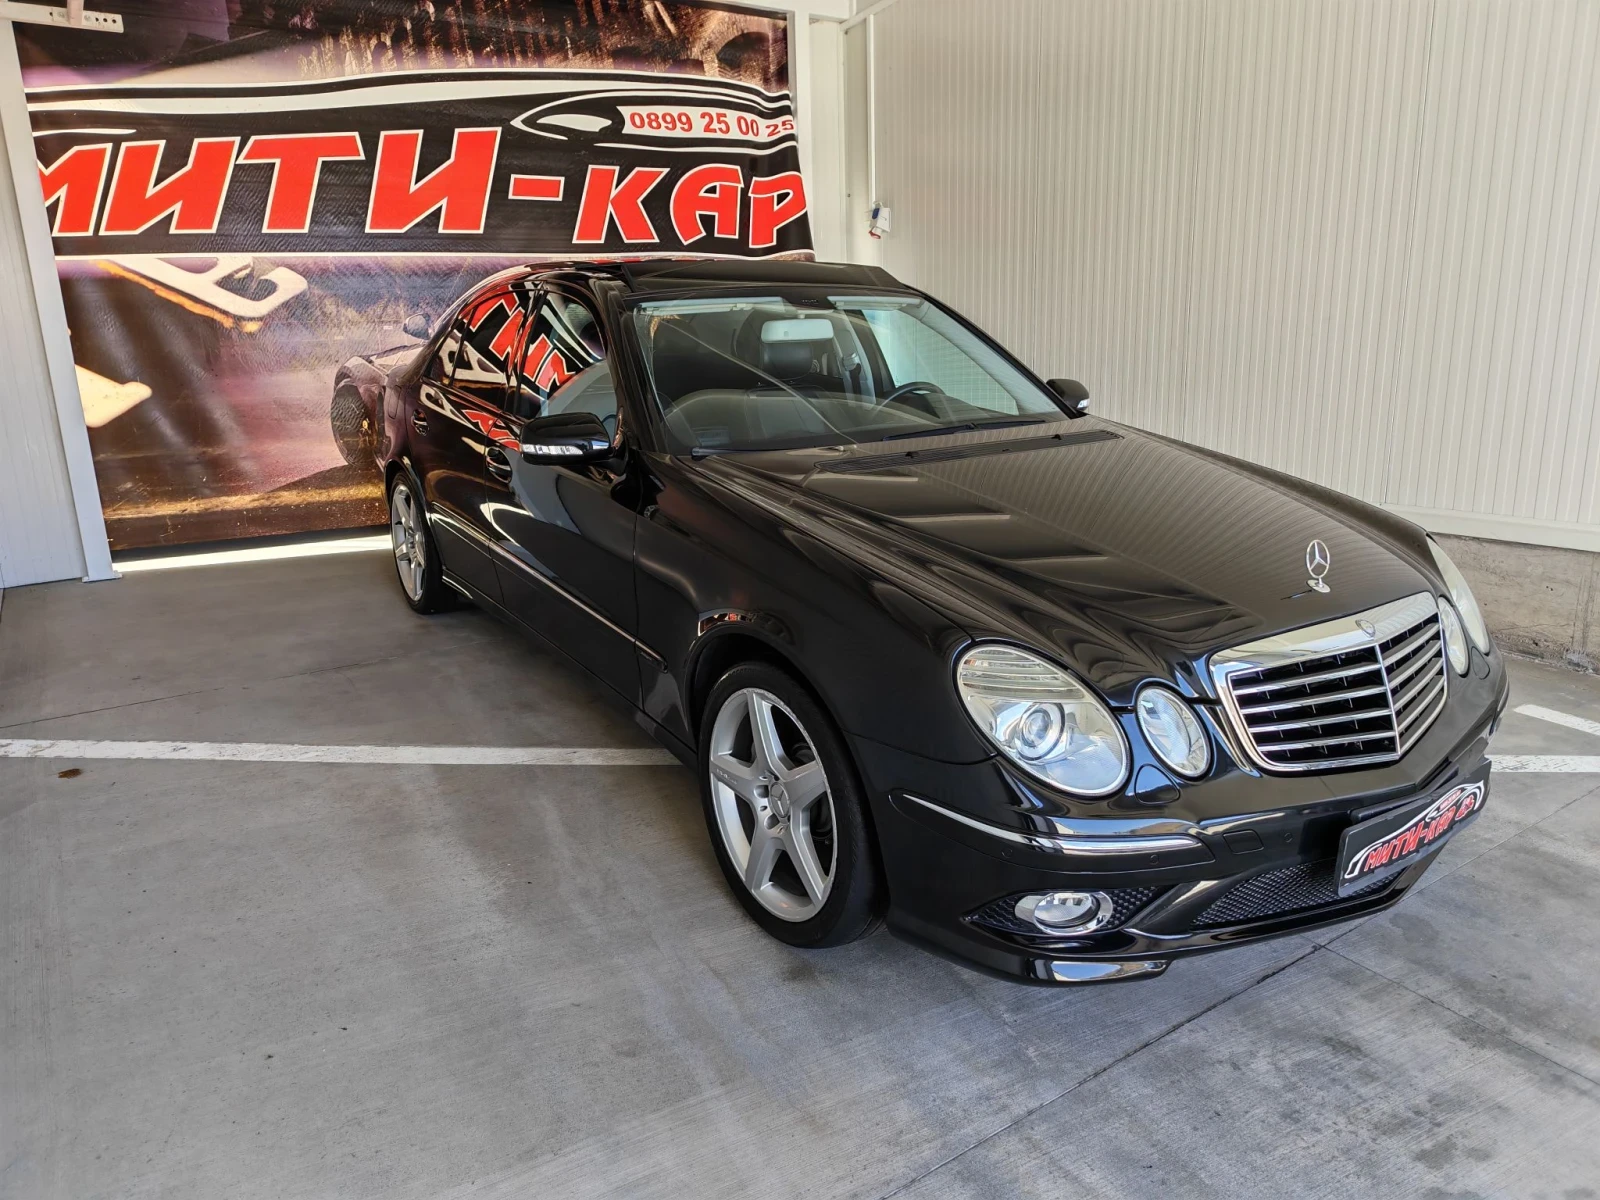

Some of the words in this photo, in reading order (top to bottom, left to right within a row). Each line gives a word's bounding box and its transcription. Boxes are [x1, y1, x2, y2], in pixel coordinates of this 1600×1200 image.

[629, 112, 693, 132] 0899
[700, 112, 730, 134] 25
[737, 116, 759, 137] 00
[765, 119, 794, 137] 25
